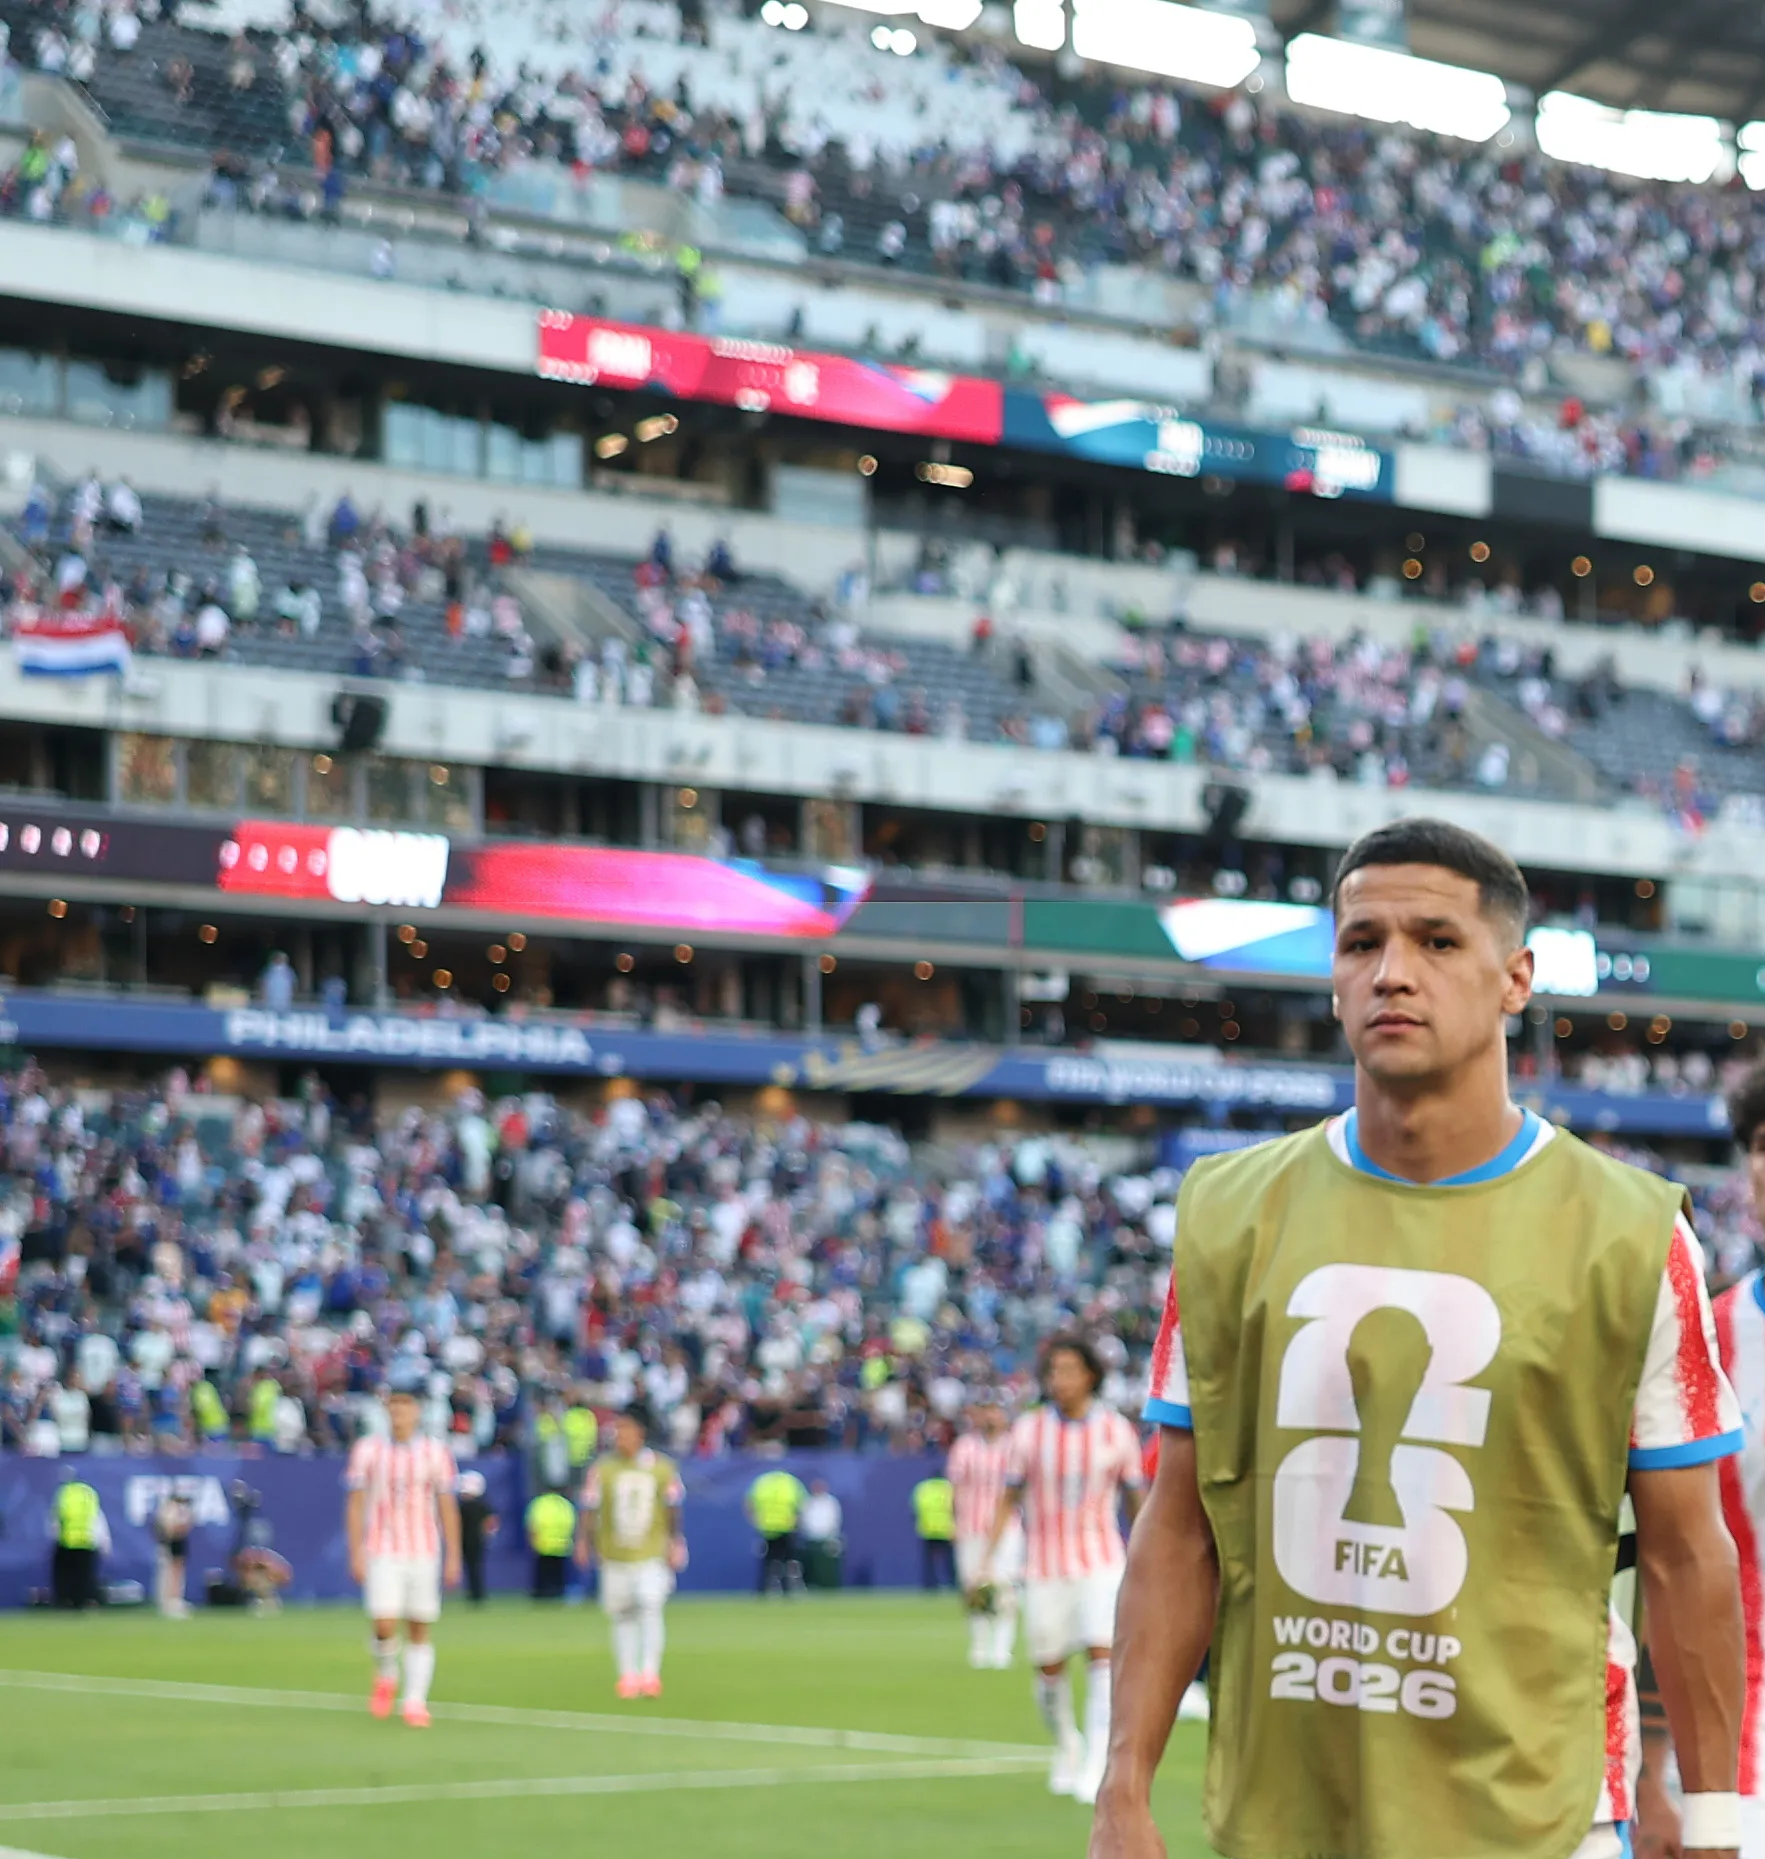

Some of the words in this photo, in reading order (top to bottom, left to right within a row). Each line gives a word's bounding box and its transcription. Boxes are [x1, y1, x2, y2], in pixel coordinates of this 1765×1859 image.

[226, 1008, 592, 1064] PHILADELPHIA
[1335, 1539, 1409, 1582] FIFA
[1272, 1615, 1380, 1656] WORLD
[1386, 1628, 1462, 1666] CUP
[1270, 1651, 1458, 1720] 2026
